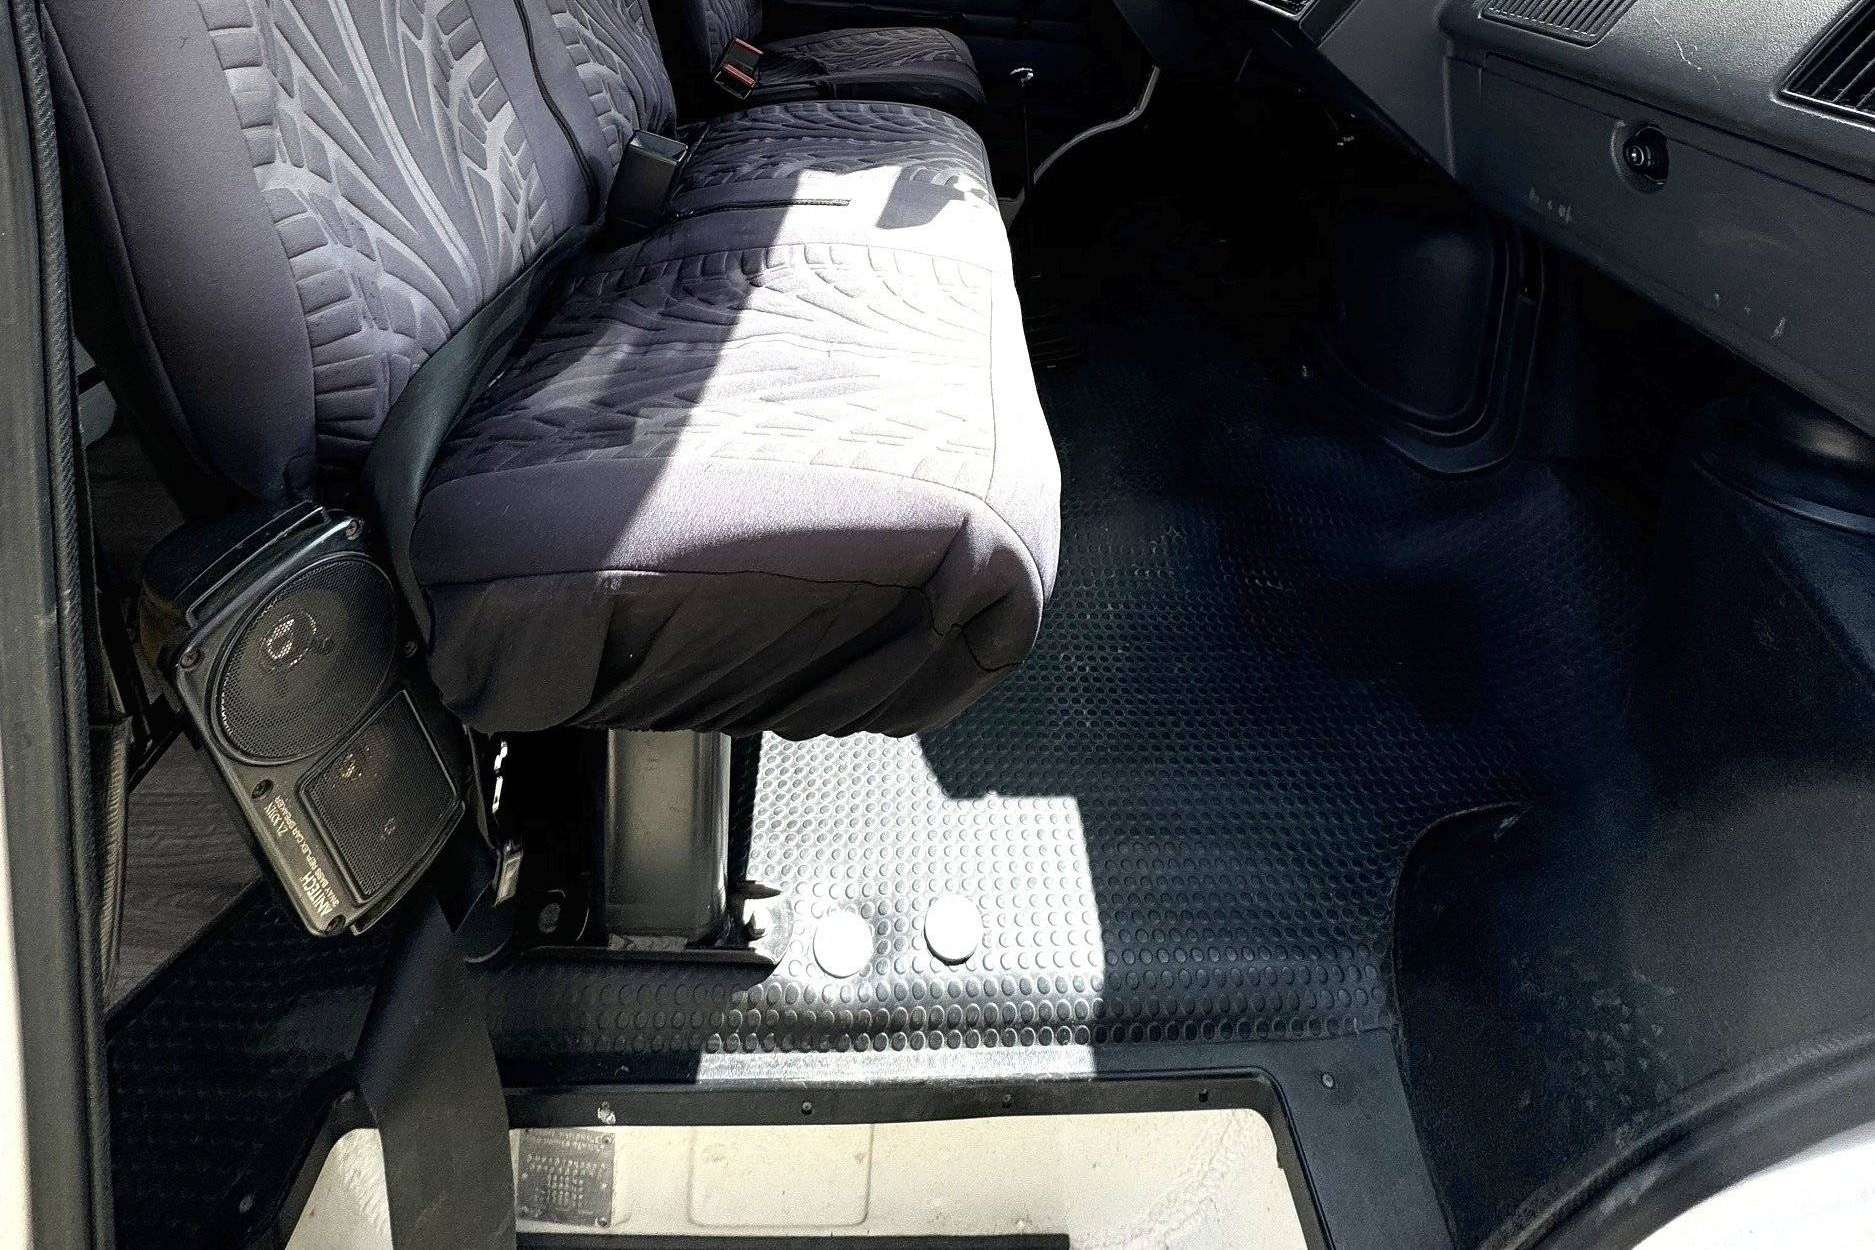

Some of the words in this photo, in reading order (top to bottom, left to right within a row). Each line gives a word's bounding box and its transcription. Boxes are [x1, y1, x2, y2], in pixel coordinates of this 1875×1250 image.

[275, 795, 297, 830] SPEAKER
[292, 827, 304, 844] CAR
[300, 841, 319, 871] REFLEX
[314, 867, 329, 888] BASS
[300, 870, 333, 917] ANITECH
